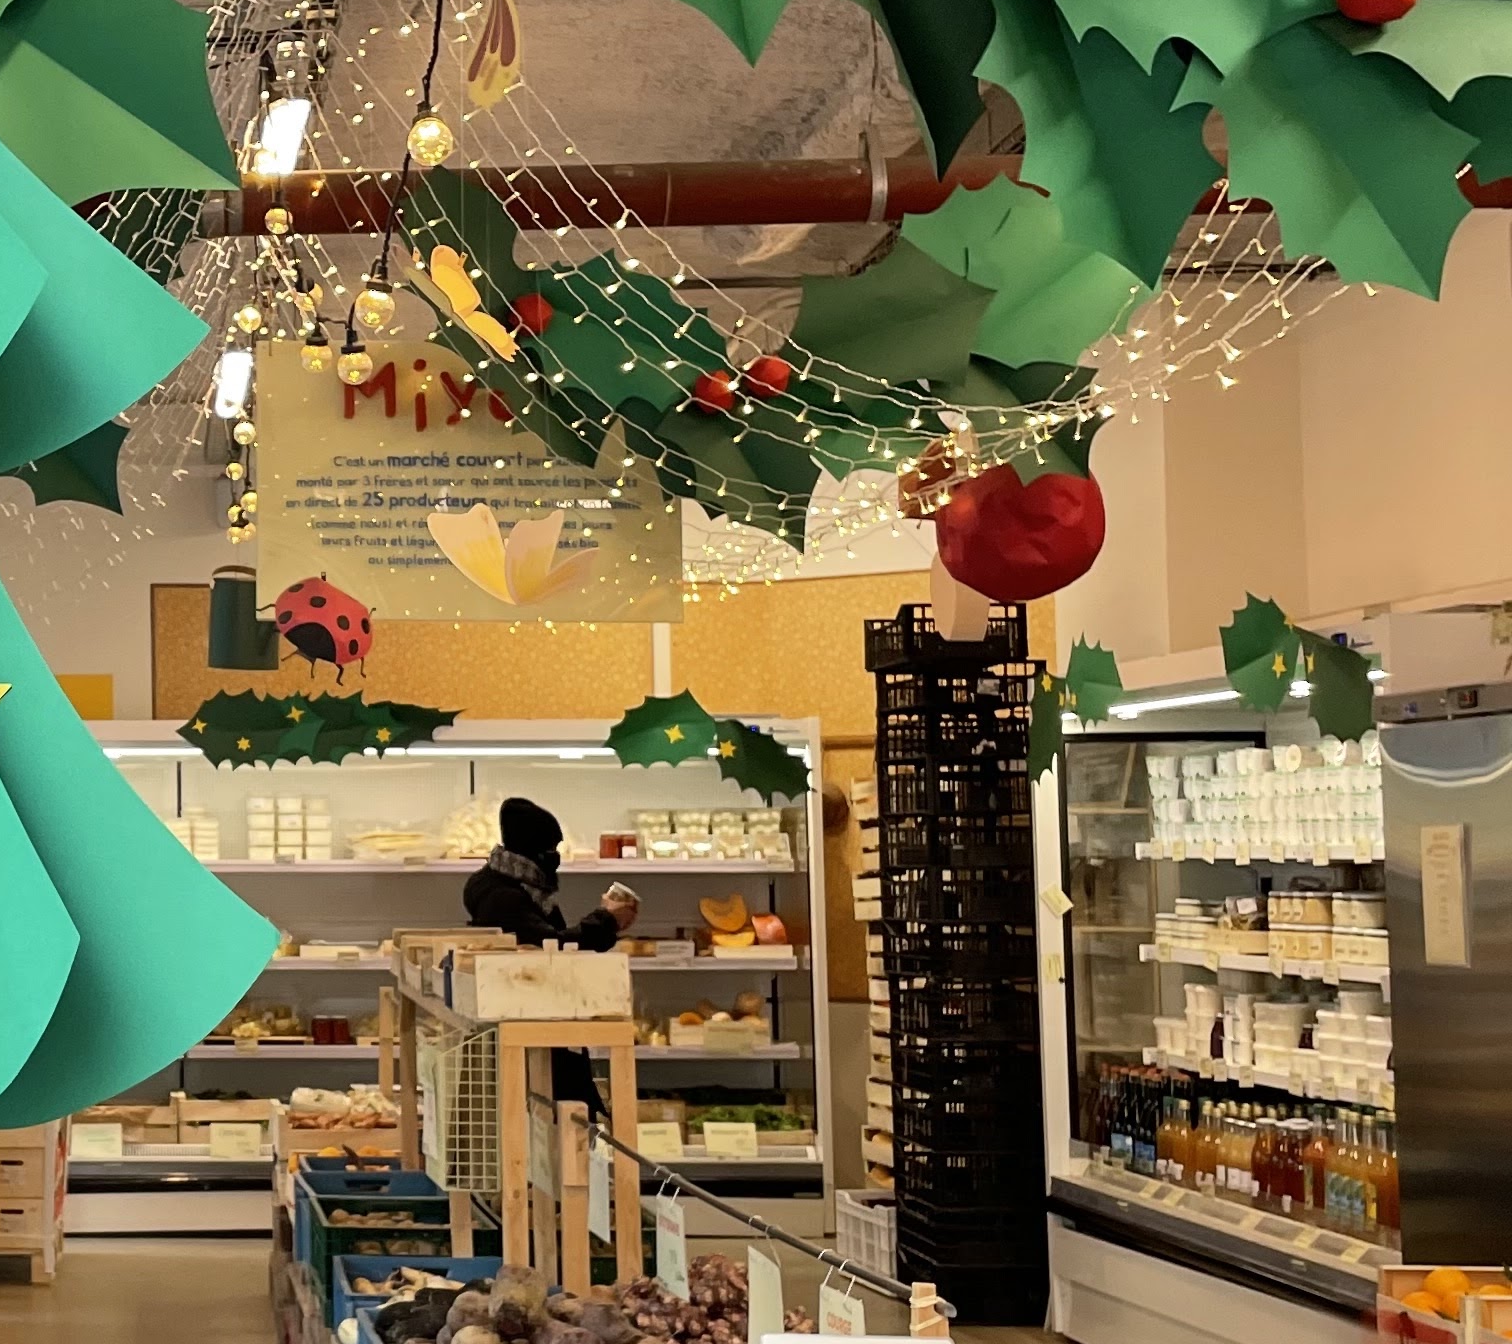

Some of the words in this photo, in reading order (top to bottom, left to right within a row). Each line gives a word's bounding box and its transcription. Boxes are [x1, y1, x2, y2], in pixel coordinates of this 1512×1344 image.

[333, 455, 365, 468] C'est
[368, 458, 385, 468] un
[387, 452, 451, 468] marché
[456, 452, 522, 468] couvrt
[296, 476, 333, 488] monté
[336, 479, 359, 489] par
[363, 476, 371, 488] 3
[374, 475, 413, 488] frères
[415, 476, 428, 487] et
[304, 496, 340, 508] direct
[344, 497, 358, 507] de
[362, 492, 384, 507] 25
[389, 493, 486, 510] producteurs
